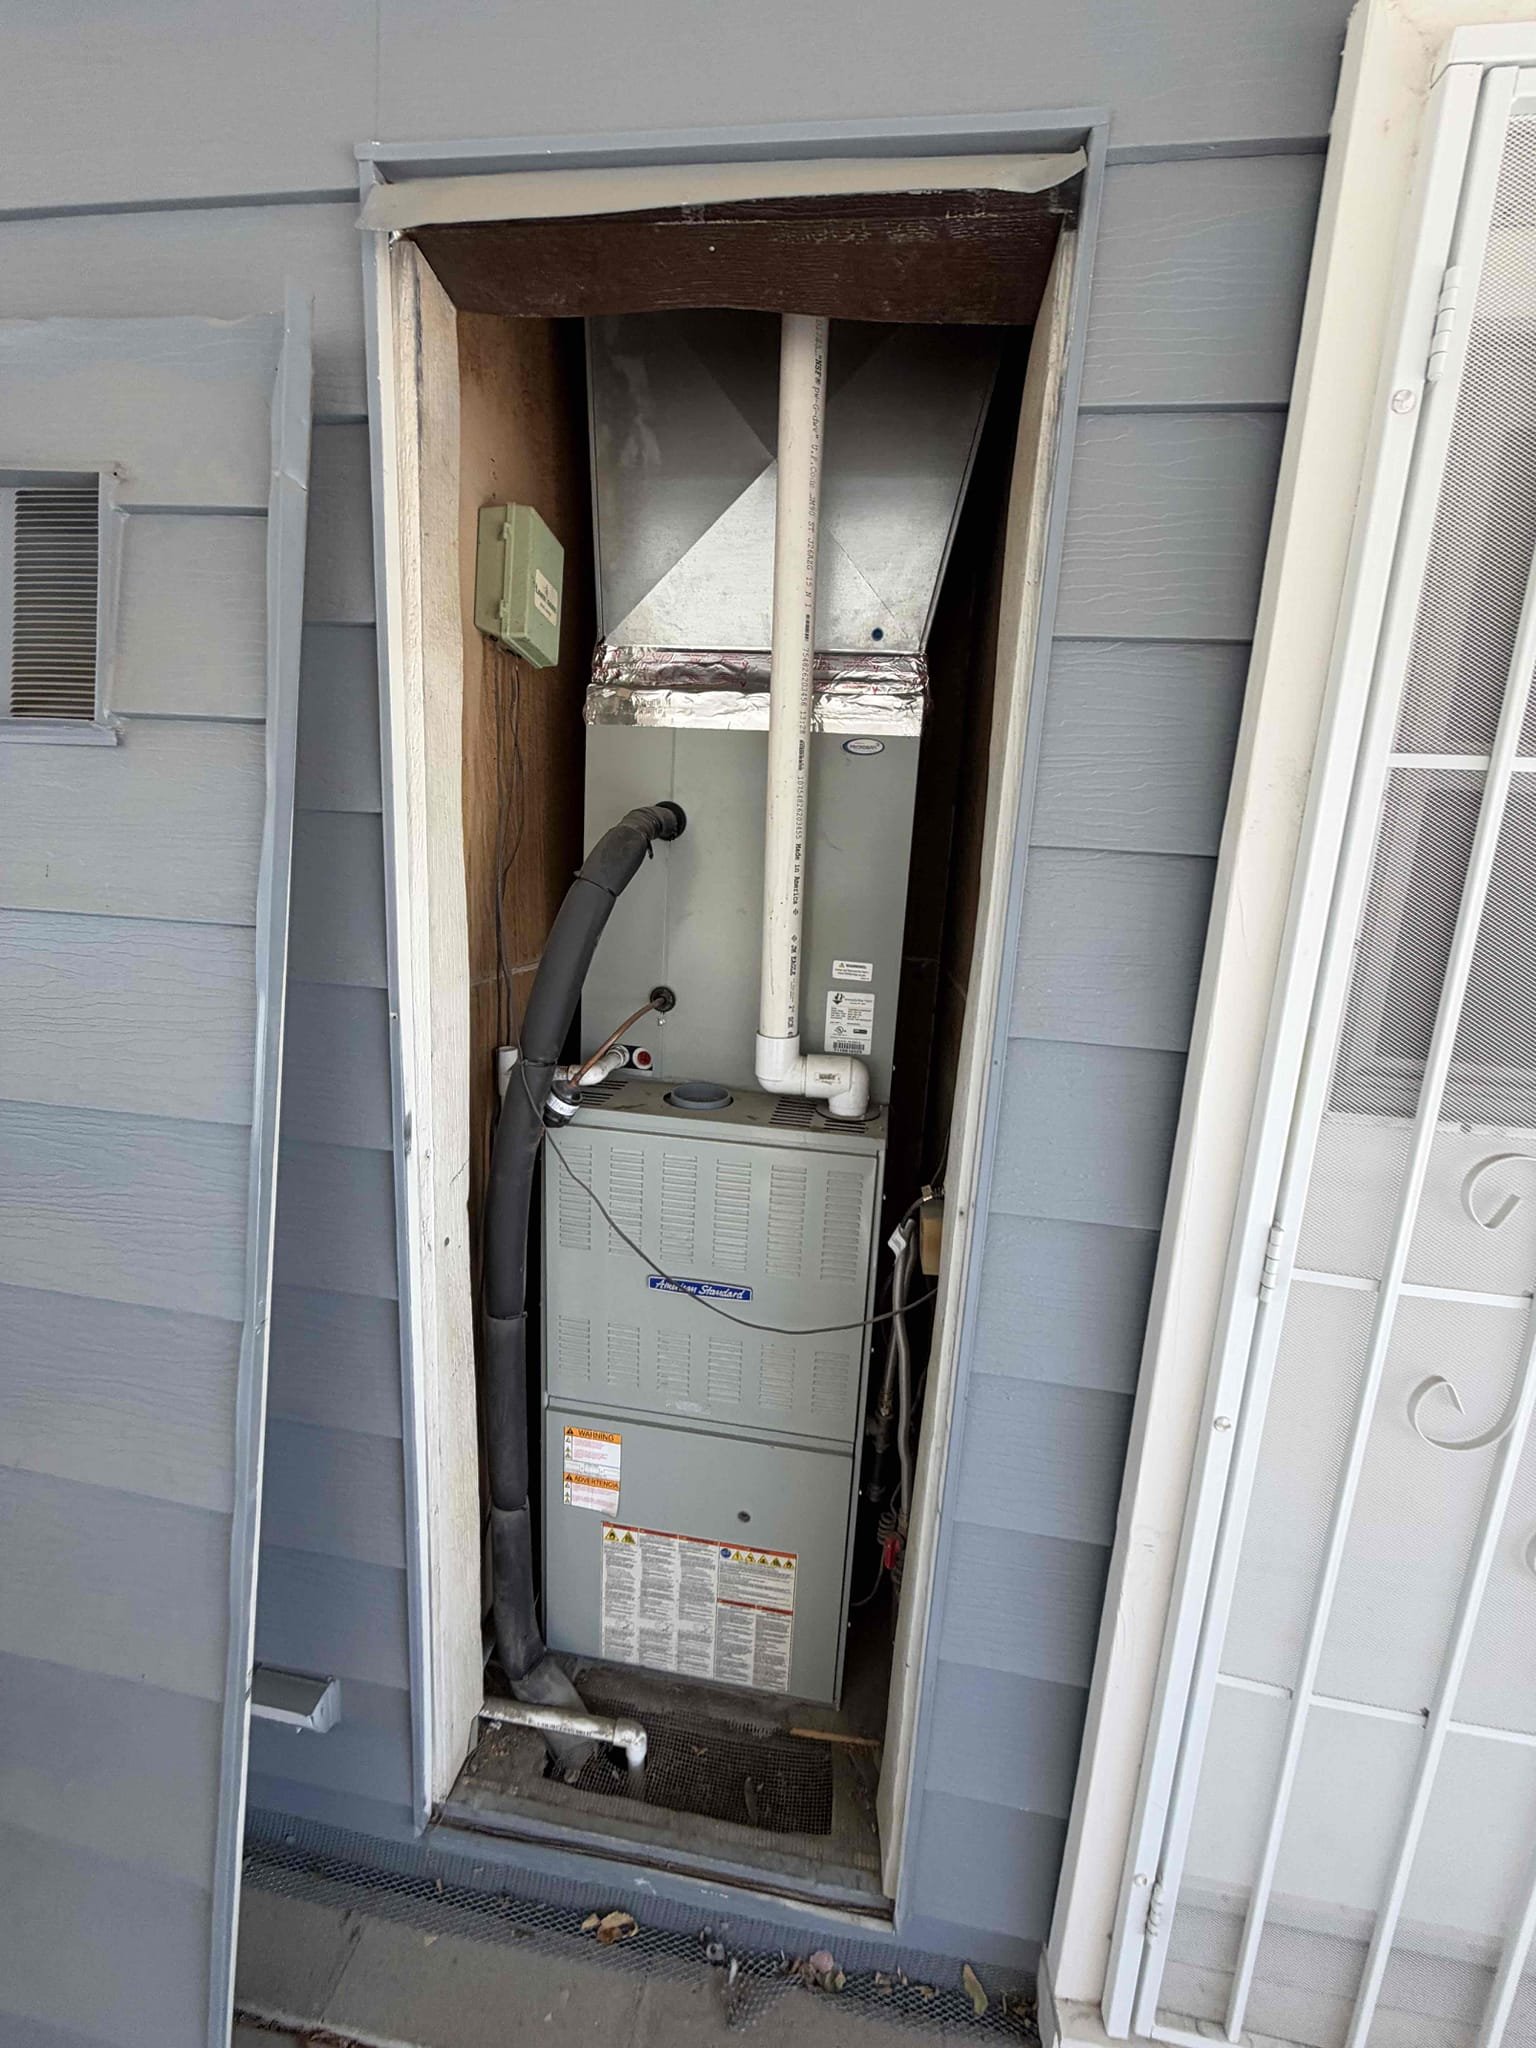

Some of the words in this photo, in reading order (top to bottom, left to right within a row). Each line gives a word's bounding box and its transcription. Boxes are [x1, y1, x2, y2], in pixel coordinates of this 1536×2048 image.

[794, 843, 802, 861] Made
[794, 864, 801, 873] in
[792, 876, 800, 905] America
[789, 956, 797, 977] EAGLE
[698, 1285, 745, 1299] Standard
[578, 1428, 615, 1441] WARNING
[574, 1474, 620, 1489] ADVERTENCIA
